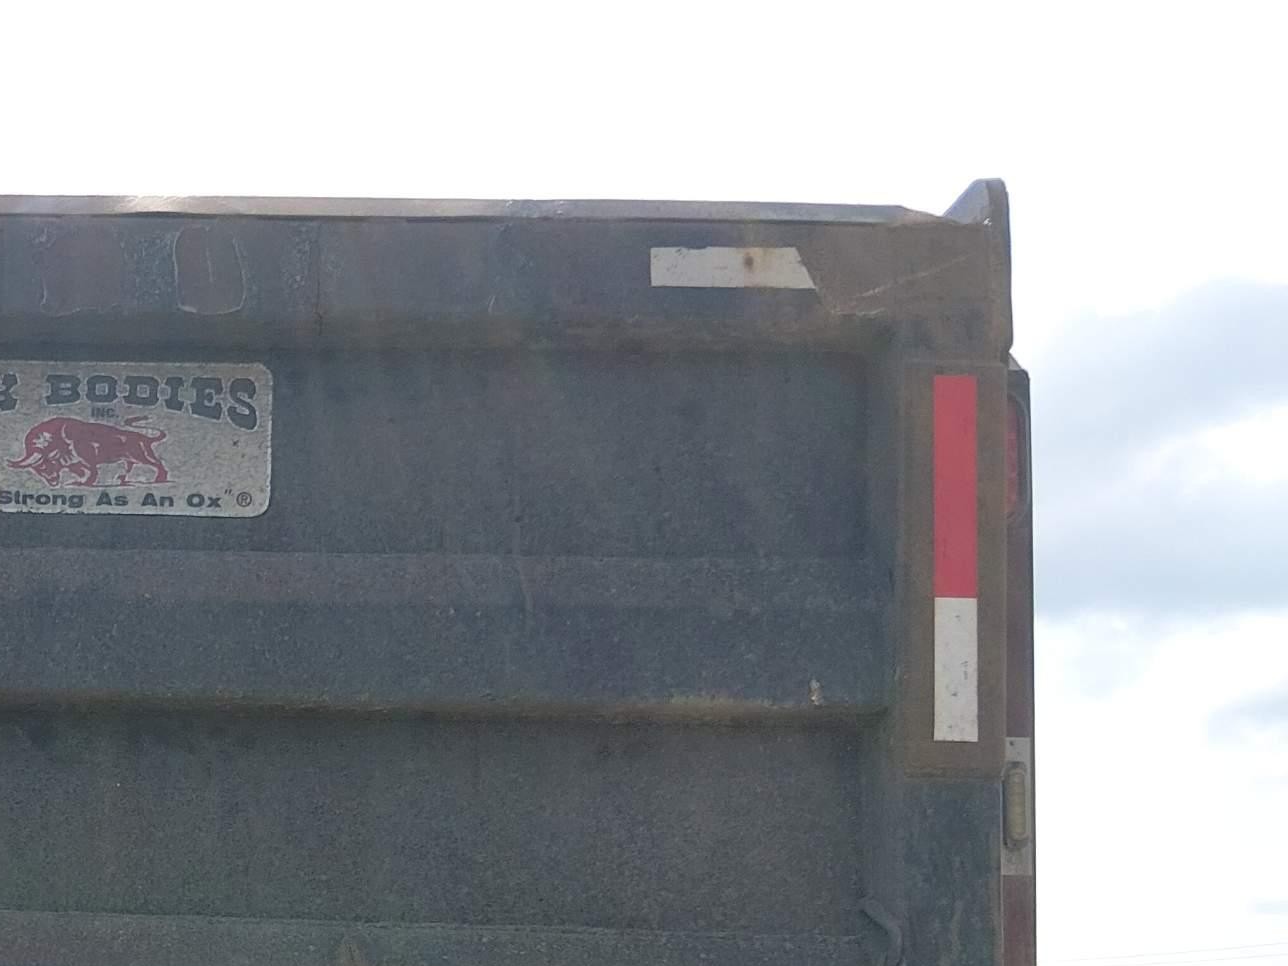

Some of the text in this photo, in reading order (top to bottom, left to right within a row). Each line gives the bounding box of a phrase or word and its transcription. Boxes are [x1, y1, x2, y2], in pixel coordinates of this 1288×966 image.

[44, 373, 259, 431] BODIES
[95, 491, 129, 507] As
[140, 492, 174, 508] An
